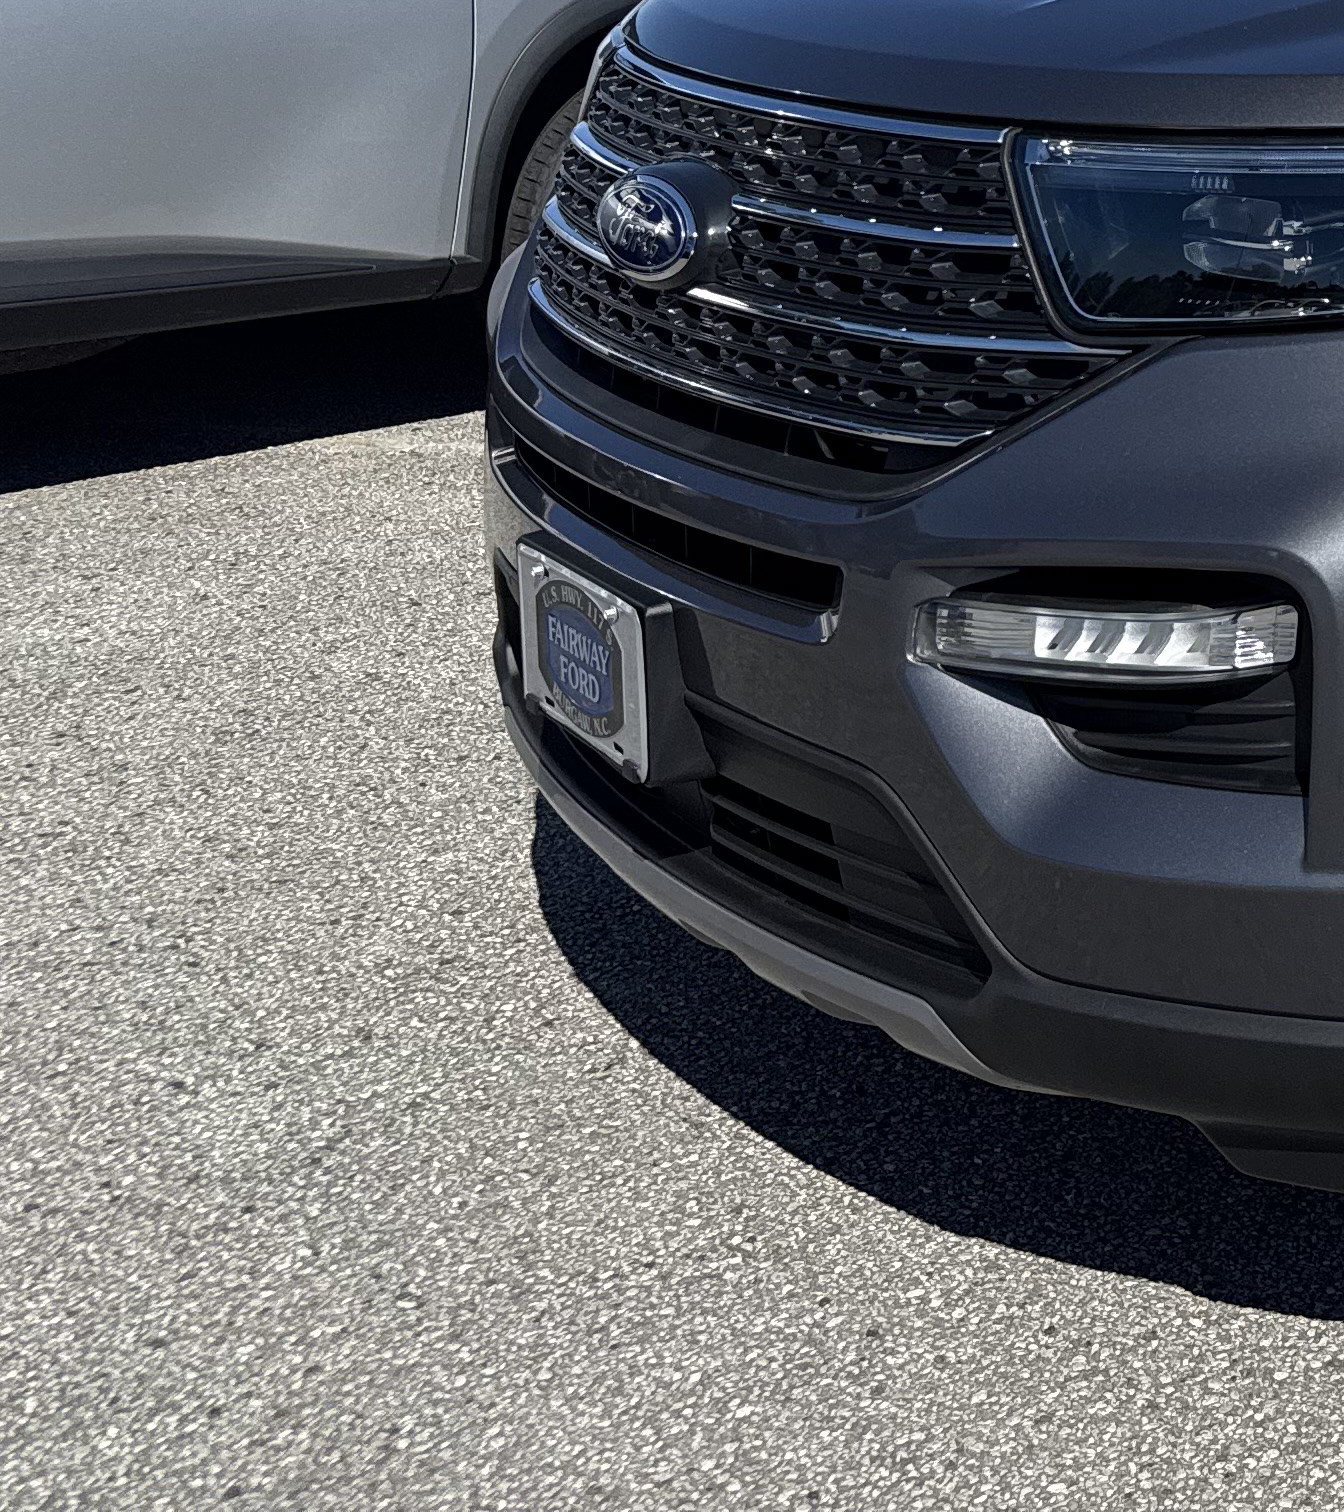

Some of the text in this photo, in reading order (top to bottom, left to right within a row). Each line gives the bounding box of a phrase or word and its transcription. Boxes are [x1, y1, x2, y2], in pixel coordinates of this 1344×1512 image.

[608, 192, 664, 259] Ford
[542, 585, 559, 608] U.S.
[561, 584, 584, 610] HWY.
[547, 614, 611, 676] FAIRWAY
[559, 654, 600, 703] FORD
